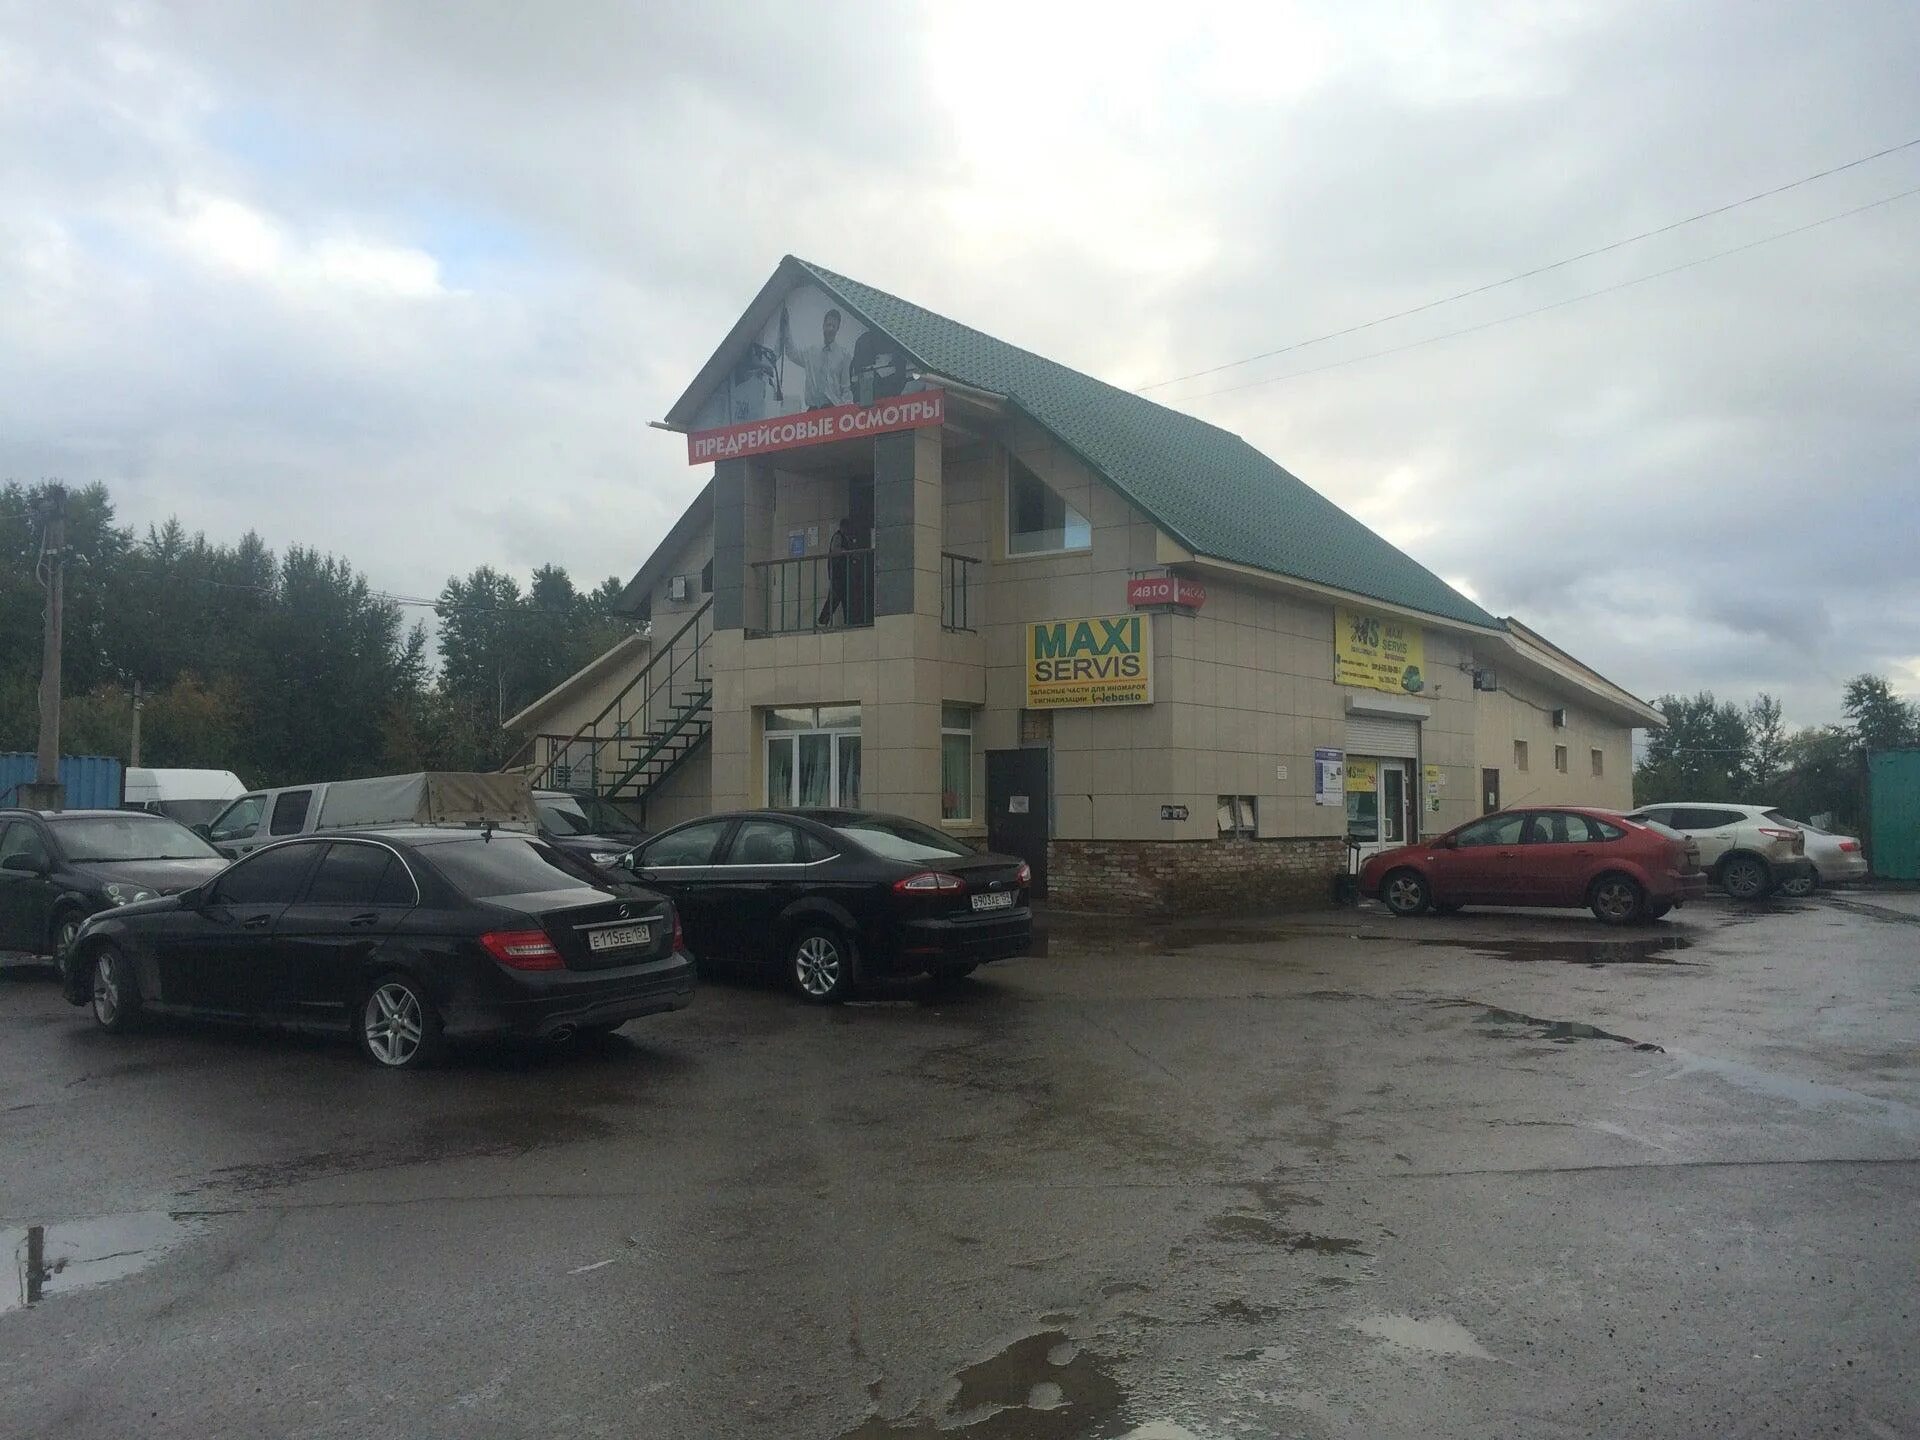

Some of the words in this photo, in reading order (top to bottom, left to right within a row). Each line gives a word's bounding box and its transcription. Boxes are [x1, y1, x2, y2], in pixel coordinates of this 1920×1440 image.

[694, 417, 835, 458] ПРЕДРЕЙСОВЫЕ
[838, 398, 941, 431] ОСМОТРЫ
[1132, 583, 1169, 598] АВТО
[1034, 617, 1141, 660] MAXI
[1034, 655, 1141, 683] SERVIS
[1030, 688, 1066, 696] ЗАПАСНЫЕ
[1067, 686, 1090, 694] ЧАСТИ
[1091, 685, 1106, 693] ДЛЯ
[1106, 683, 1146, 691] ИНОМАРОК
